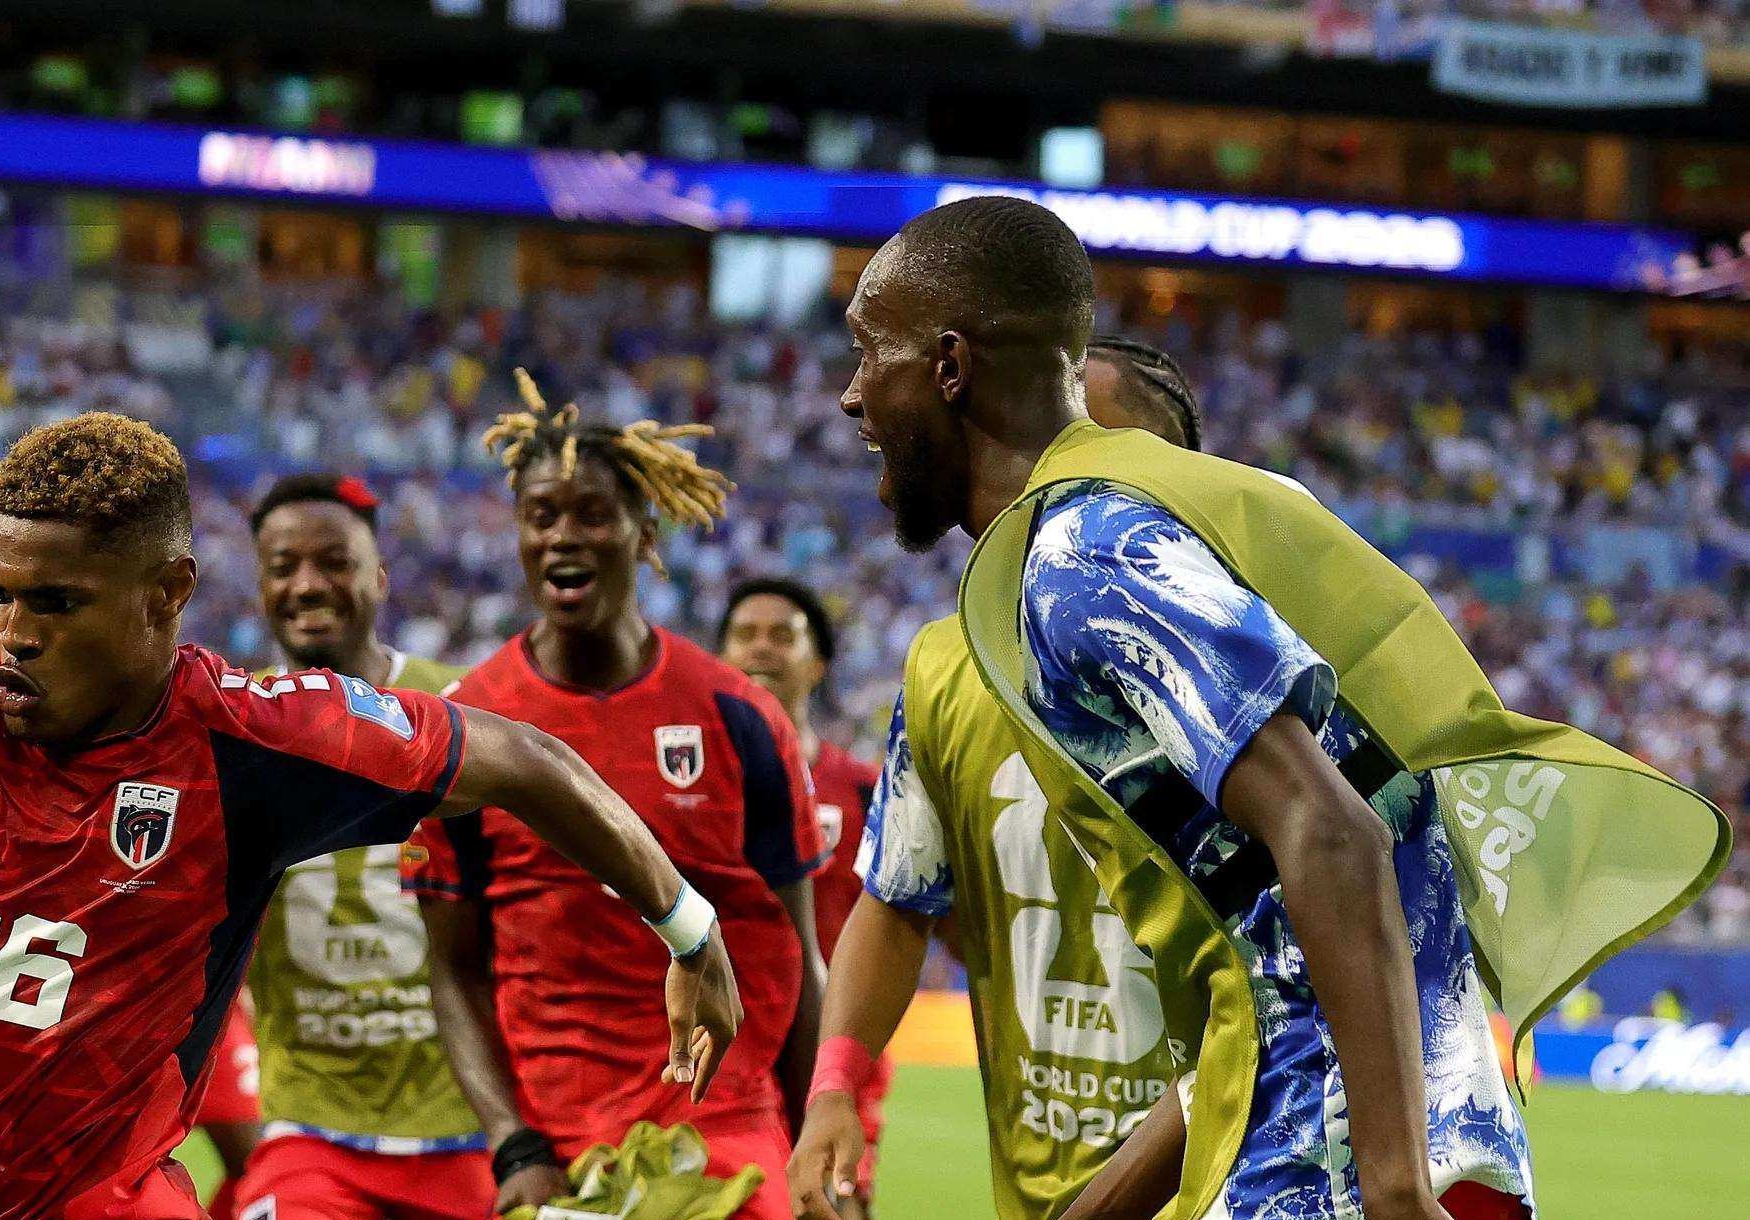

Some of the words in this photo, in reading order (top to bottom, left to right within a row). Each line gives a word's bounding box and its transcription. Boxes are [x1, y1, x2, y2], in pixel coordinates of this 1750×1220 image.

[122, 786, 175, 802] FCF
[326, 937, 389, 962] FIFA
[1043, 995, 1118, 1035] FIFA
[1104, 1070, 1168, 1104] CUP
